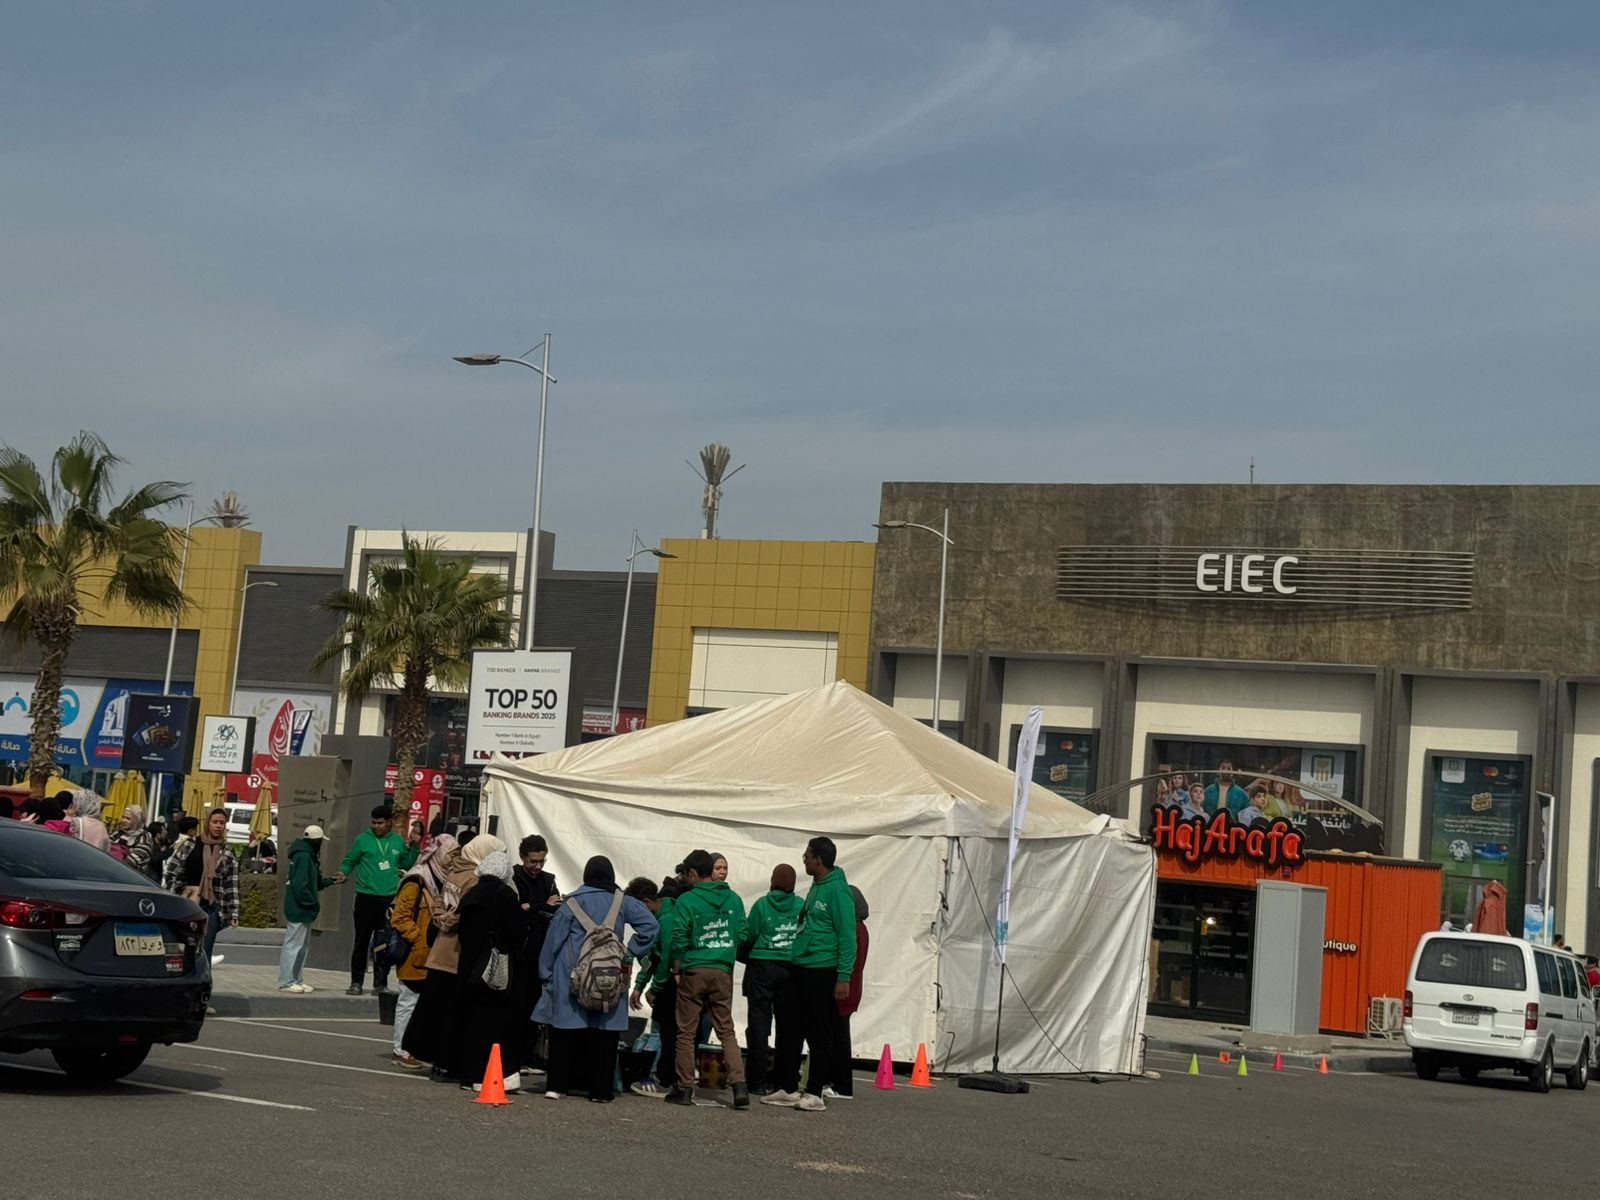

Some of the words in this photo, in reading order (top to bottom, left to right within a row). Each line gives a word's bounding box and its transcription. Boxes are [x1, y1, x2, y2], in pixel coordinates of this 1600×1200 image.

[1196, 553, 1299, 594] EIEC
[485, 688, 528, 709] TOP
[531, 689, 557, 710] 50
[483, 711, 512, 719] BANKING
[513, 711, 540, 720] BRANDS
[540, 712, 556, 720] 2025
